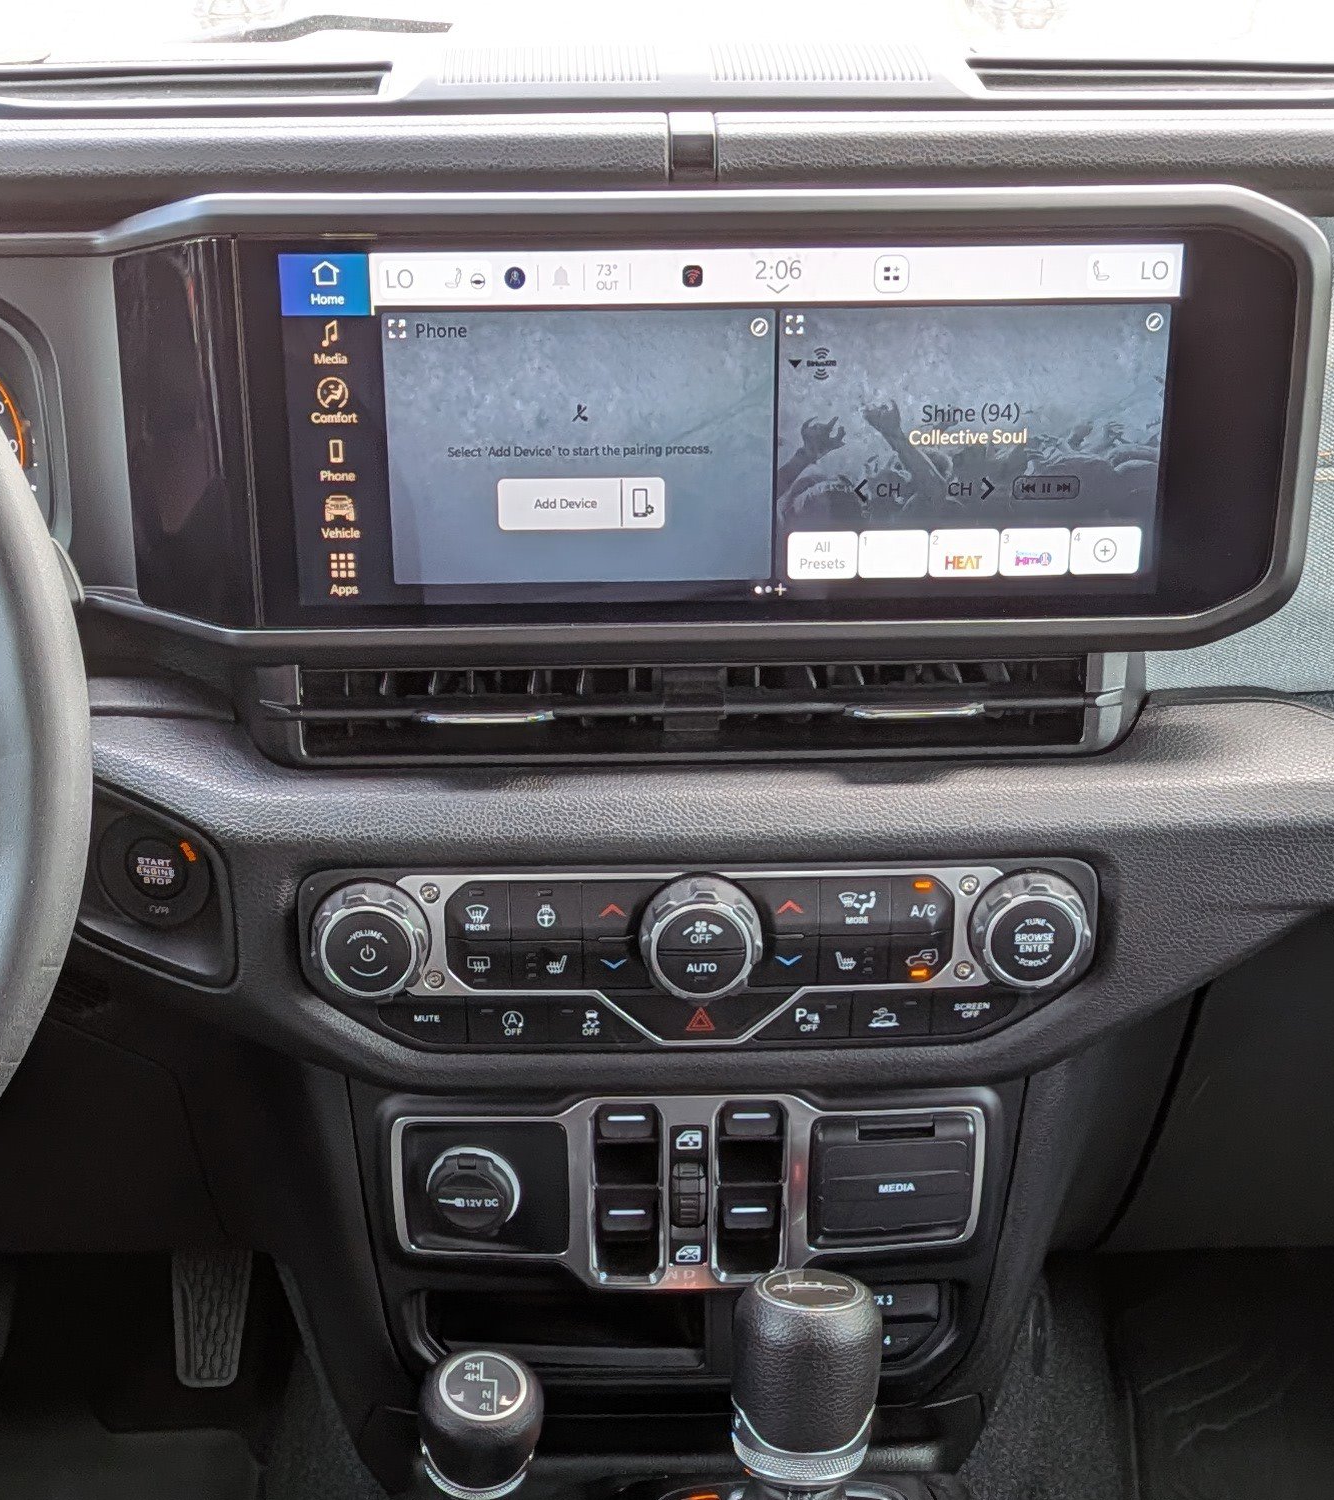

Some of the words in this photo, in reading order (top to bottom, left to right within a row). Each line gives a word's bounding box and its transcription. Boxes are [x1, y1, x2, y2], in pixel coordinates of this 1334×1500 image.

[754, 260, 803, 281] 2:06
[1140, 260, 1169, 280] LO
[385, 268, 414, 289] LO
[595, 280, 619, 291] OUT
[310, 293, 345, 305] Home
[415, 322, 468, 341] Phone
[313, 352, 349, 366] Media
[311, 411, 358, 424] Comfort
[921, 403, 976, 423] Shine
[980, 402, 1021, 425] (94)
[908, 428, 989, 447] Collective
[992, 428, 1028, 445] Soul
[447, 447, 482, 458] Select
[557, 446, 569, 457] to
[572, 446, 599, 457] start
[602, 445, 620, 456] the
[622, 445, 662, 458] pairing
[665, 445, 714, 458] process.
[319, 470, 356, 483] Phone
[876, 483, 901, 497] CH
[948, 482, 973, 497] CH
[534, 498, 558, 510] Add
[560, 498, 598, 510] Device
[321, 527, 361, 540] Vehicle
[814, 541, 831, 553] All
[799, 557, 846, 571] Presets
[944, 555, 983, 570] HEAT
[330, 583, 359, 598] Apps
[137, 856, 172, 867] START
[136, 866, 175, 877] ENGINE
[143, 876, 173, 885] STOP
[910, 904, 937, 919] A/C
[845, 916, 869, 925] MODE
[464, 923, 491, 932] FRONT
[349, 929, 383, 941] VOLUME
[690, 933, 713, 945] OFF
[1014, 933, 1055, 942] BROWSE
[1019, 944, 1050, 953] ENTER
[685, 961, 718, 974] AUTO
[953, 1002, 991, 1012] SCREEN
[413, 1014, 441, 1023] MUTE
[794, 1008, 807, 1023] P
[961, 1009, 980, 1019] OFF
[504, 1028, 523, 1037] OFF
[582, 1028, 600, 1036] OFF
[800, 1024, 819, 1033] OFF
[878, 1182, 916, 1195] MEDIA
[484, 1198, 499, 1208] DC
[886, 1294, 894, 1306] 3
[463, 1362, 480, 1371] 2H
[463, 1373, 480, 1382] 4H
[481, 1390, 492, 1399] N
[478, 1402, 493, 1412] 4L
